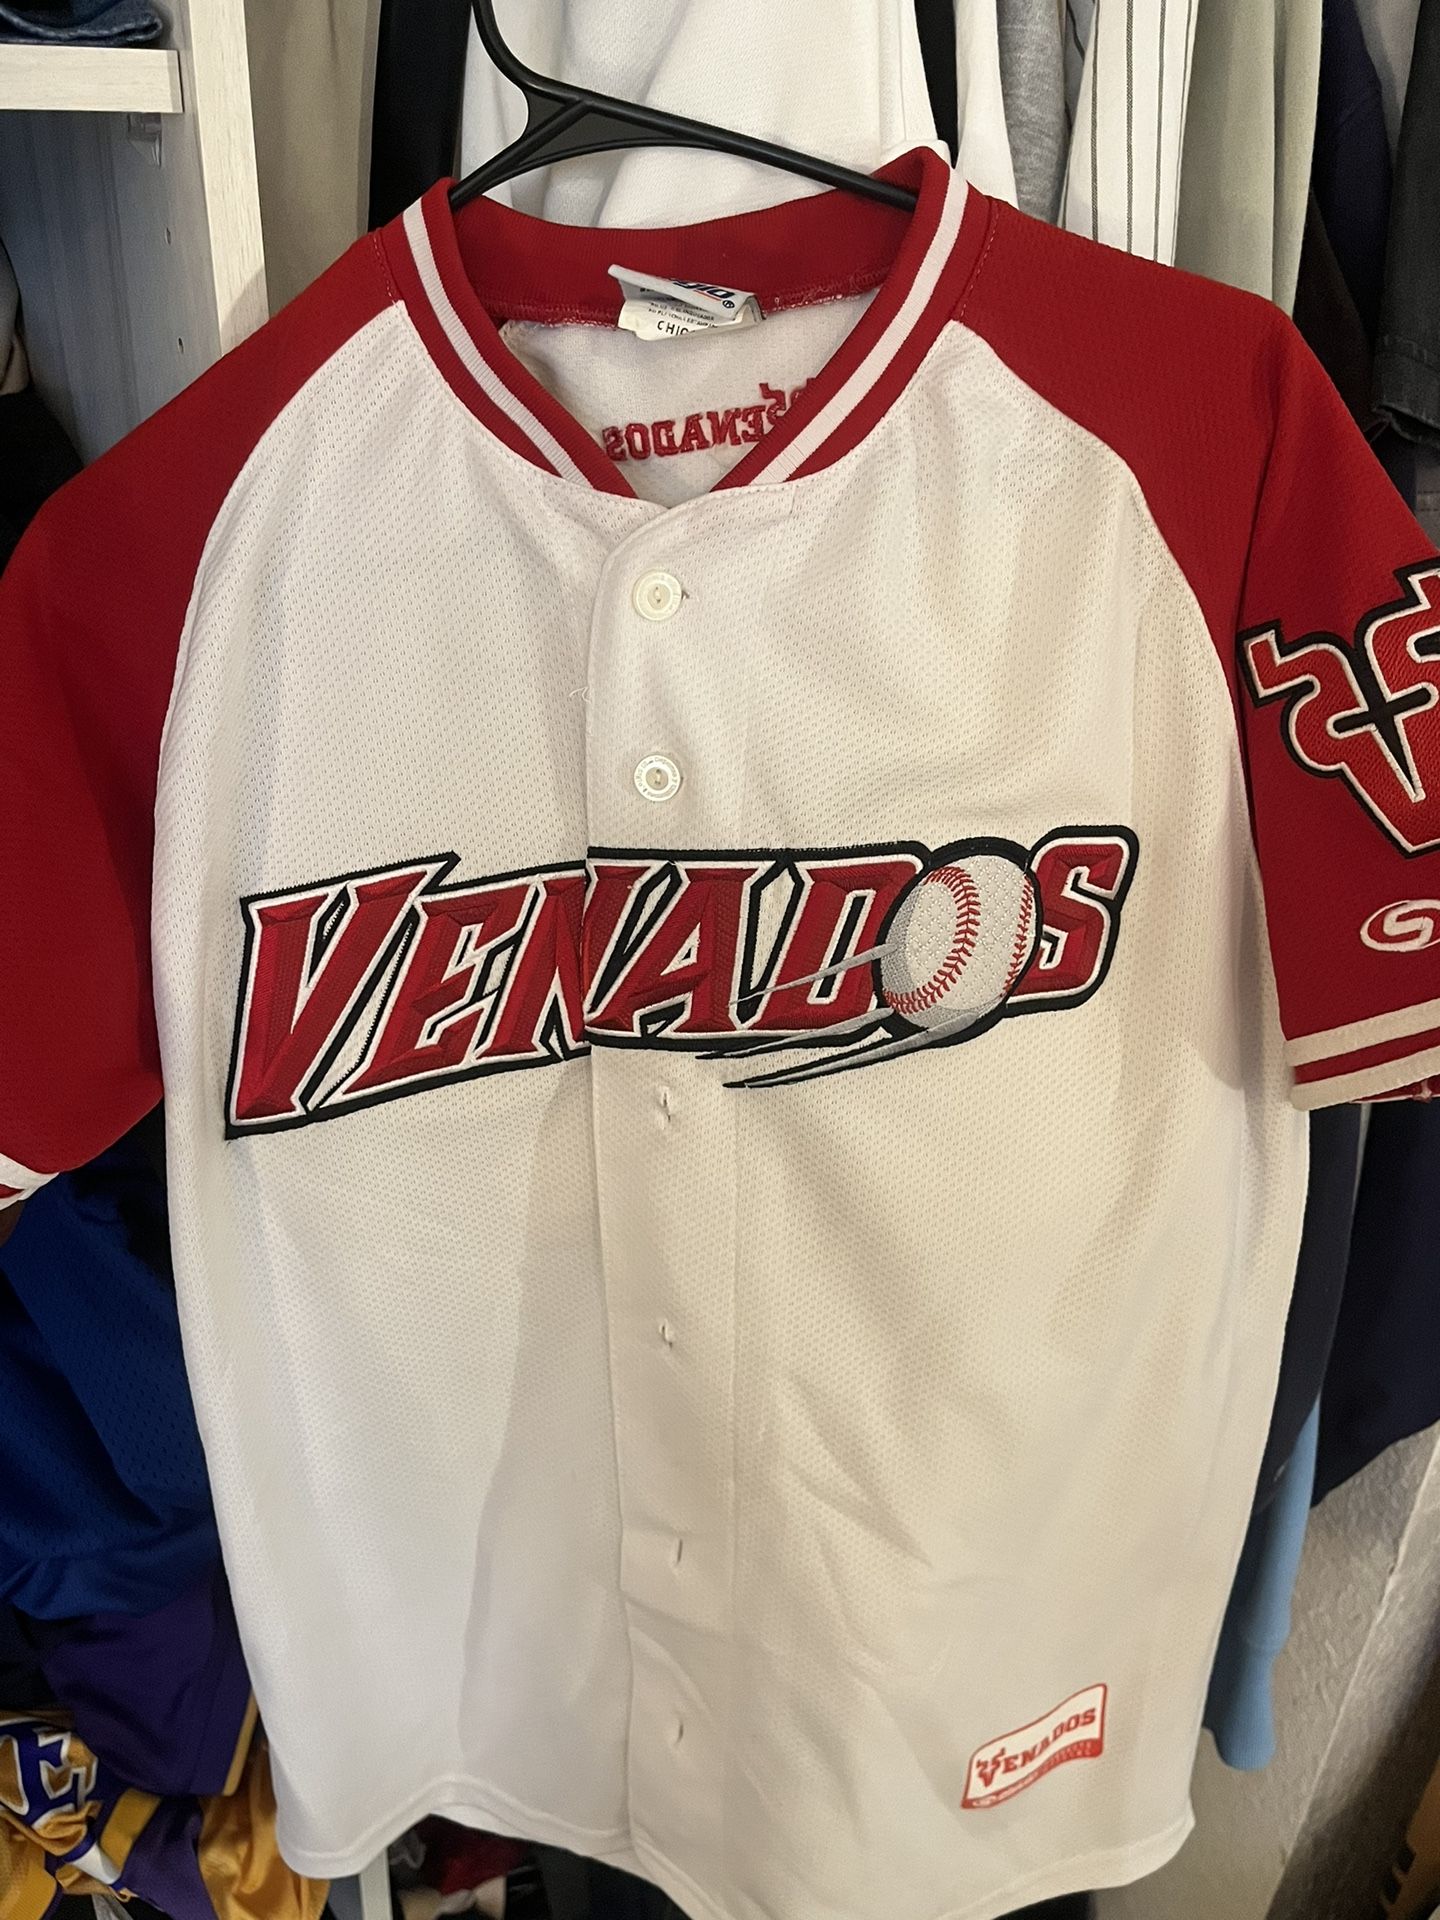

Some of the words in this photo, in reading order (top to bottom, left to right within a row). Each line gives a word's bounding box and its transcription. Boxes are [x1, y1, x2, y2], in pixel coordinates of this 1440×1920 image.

[657, 320, 695, 336] CHIC
[226, 825, 1139, 1138] VENADOS
[976, 1708, 1096, 1788] VENADOS
